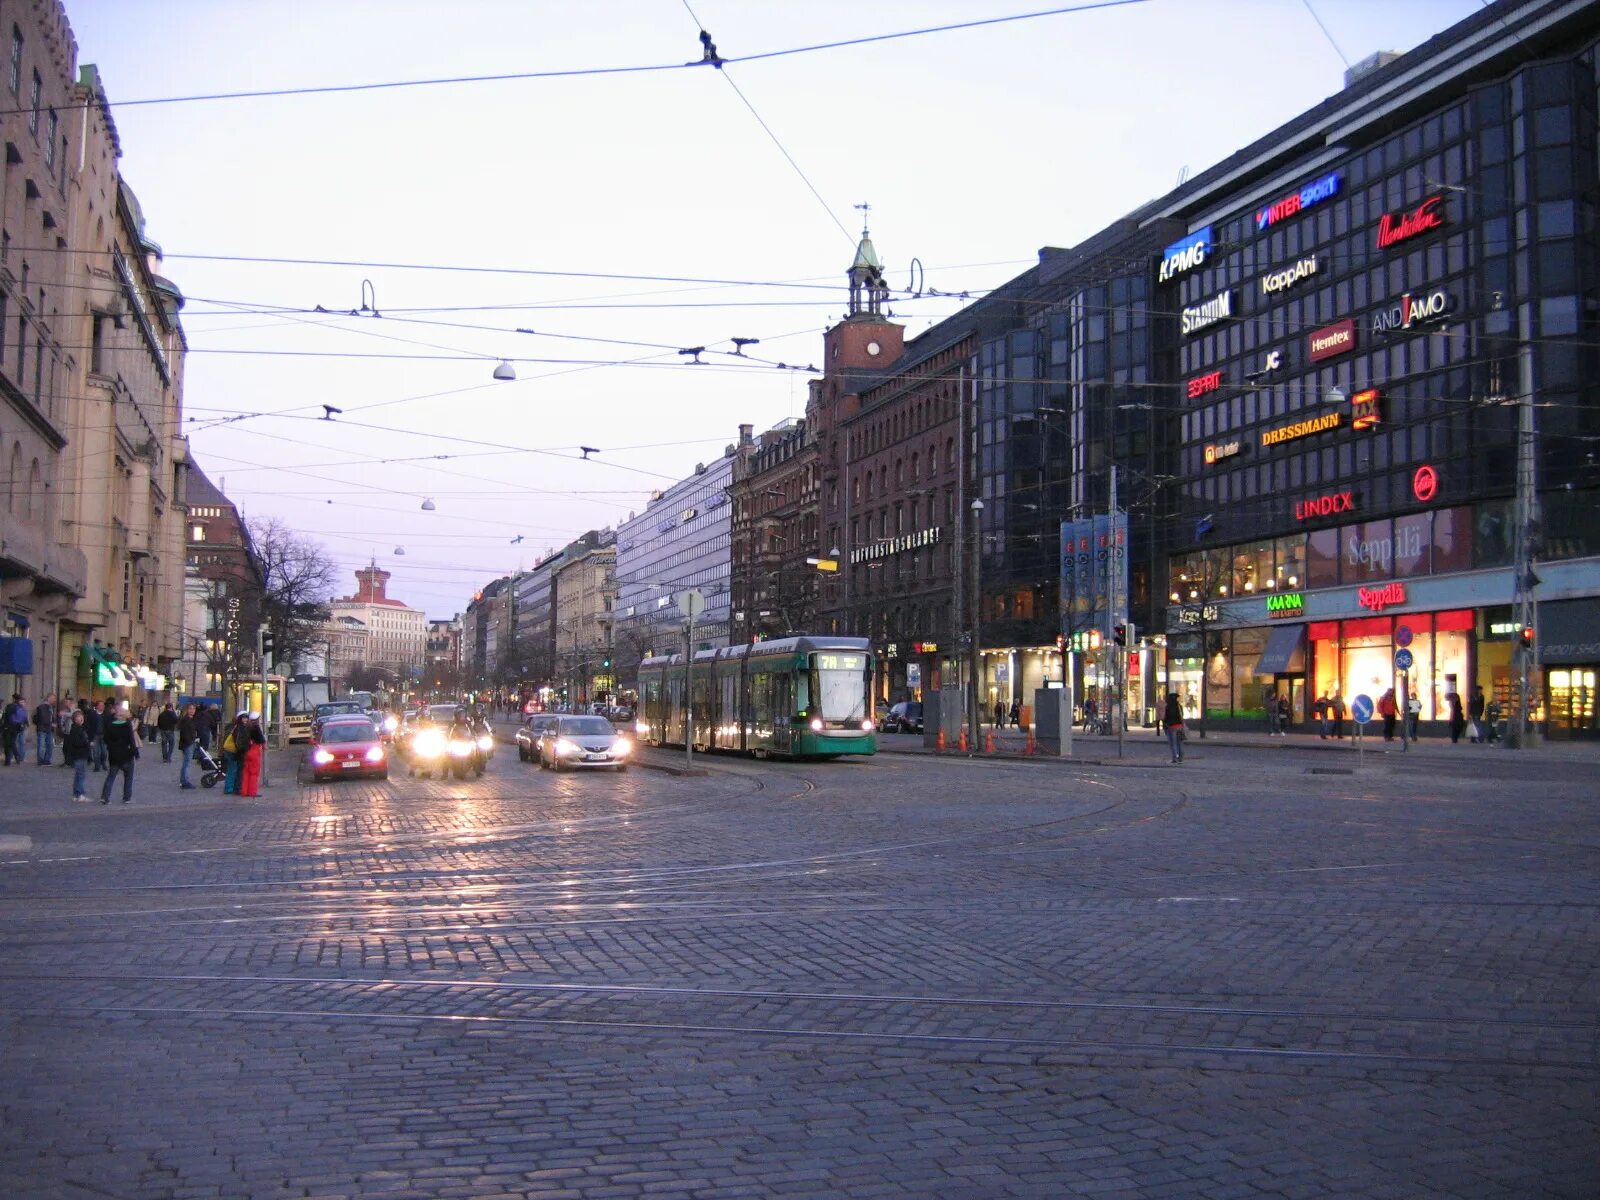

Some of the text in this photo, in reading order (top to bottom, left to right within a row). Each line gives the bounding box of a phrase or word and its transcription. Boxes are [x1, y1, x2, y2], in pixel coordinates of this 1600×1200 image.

[1268, 174, 1339, 224] INTERSPORT
[1158, 241, 1204, 283] KPMG
[1182, 293, 1230, 334] STADIUM
[1311, 330, 1350, 353] Hemtex
[1187, 372, 1222, 398] ESPRIT
[1262, 413, 1341, 447] DRESSMANN
[1295, 492, 1353, 521] LINDEX
[1267, 594, 1302, 611] KAARNA
[1358, 583, 1405, 610] Seppälä
